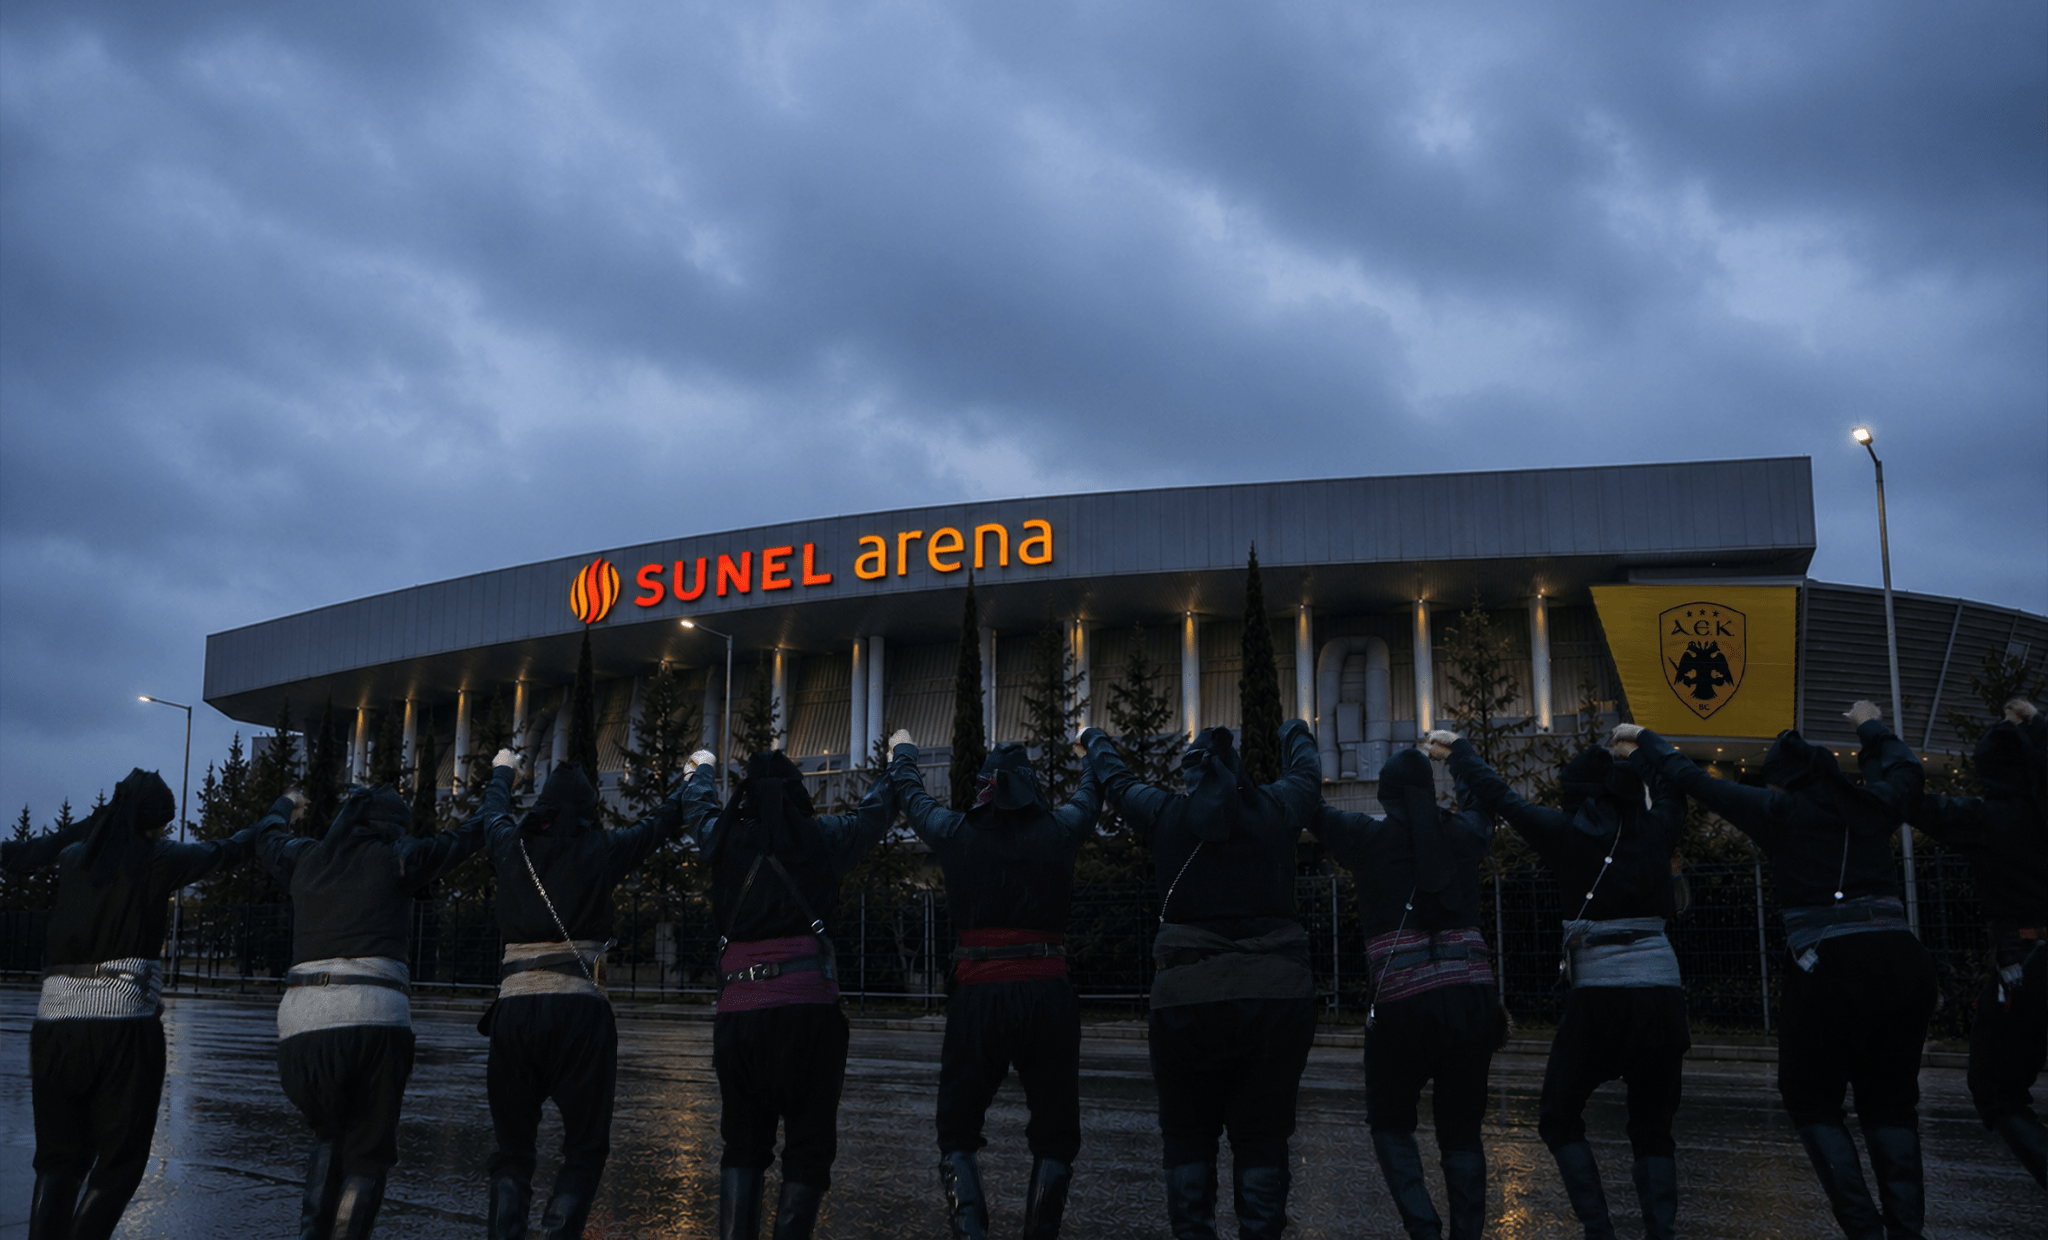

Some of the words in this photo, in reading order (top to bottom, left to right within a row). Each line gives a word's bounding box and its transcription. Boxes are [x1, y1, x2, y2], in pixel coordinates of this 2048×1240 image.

[634, 543, 833, 607] SUNEL
[854, 519, 1053, 580] arena
[1698, 703, 1710, 711] BC
